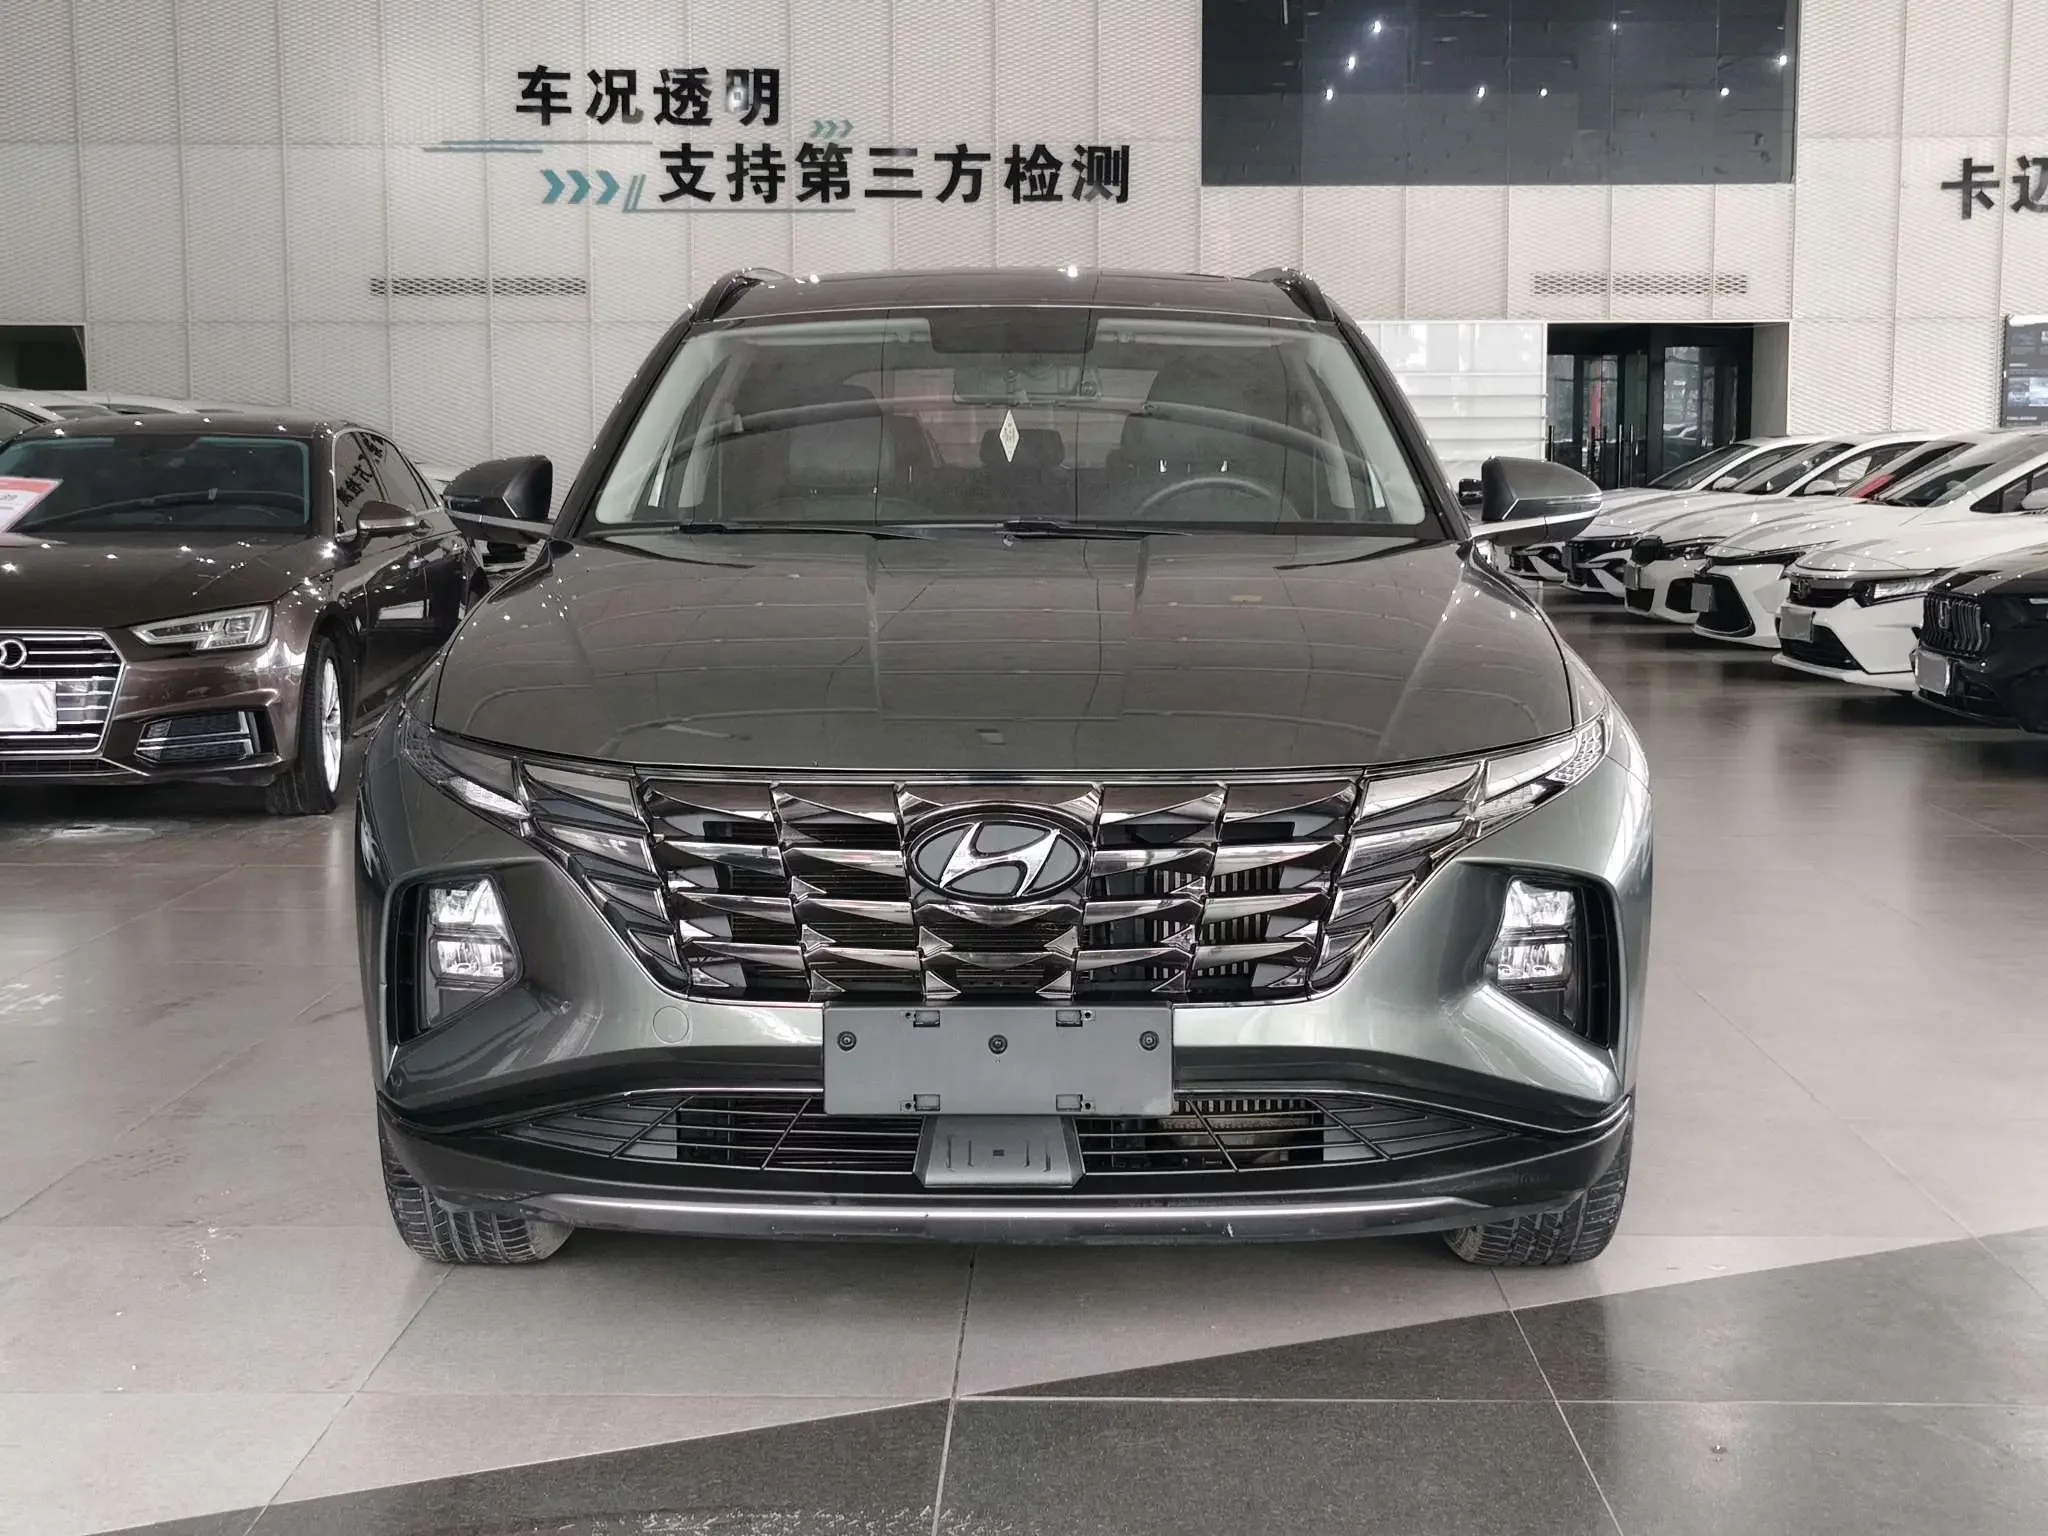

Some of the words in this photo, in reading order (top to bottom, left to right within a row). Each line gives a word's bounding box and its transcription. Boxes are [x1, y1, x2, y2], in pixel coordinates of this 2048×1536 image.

[515, 64, 781, 127] 车况透明
[658, 142, 1131, 205] 支持第三方检测
